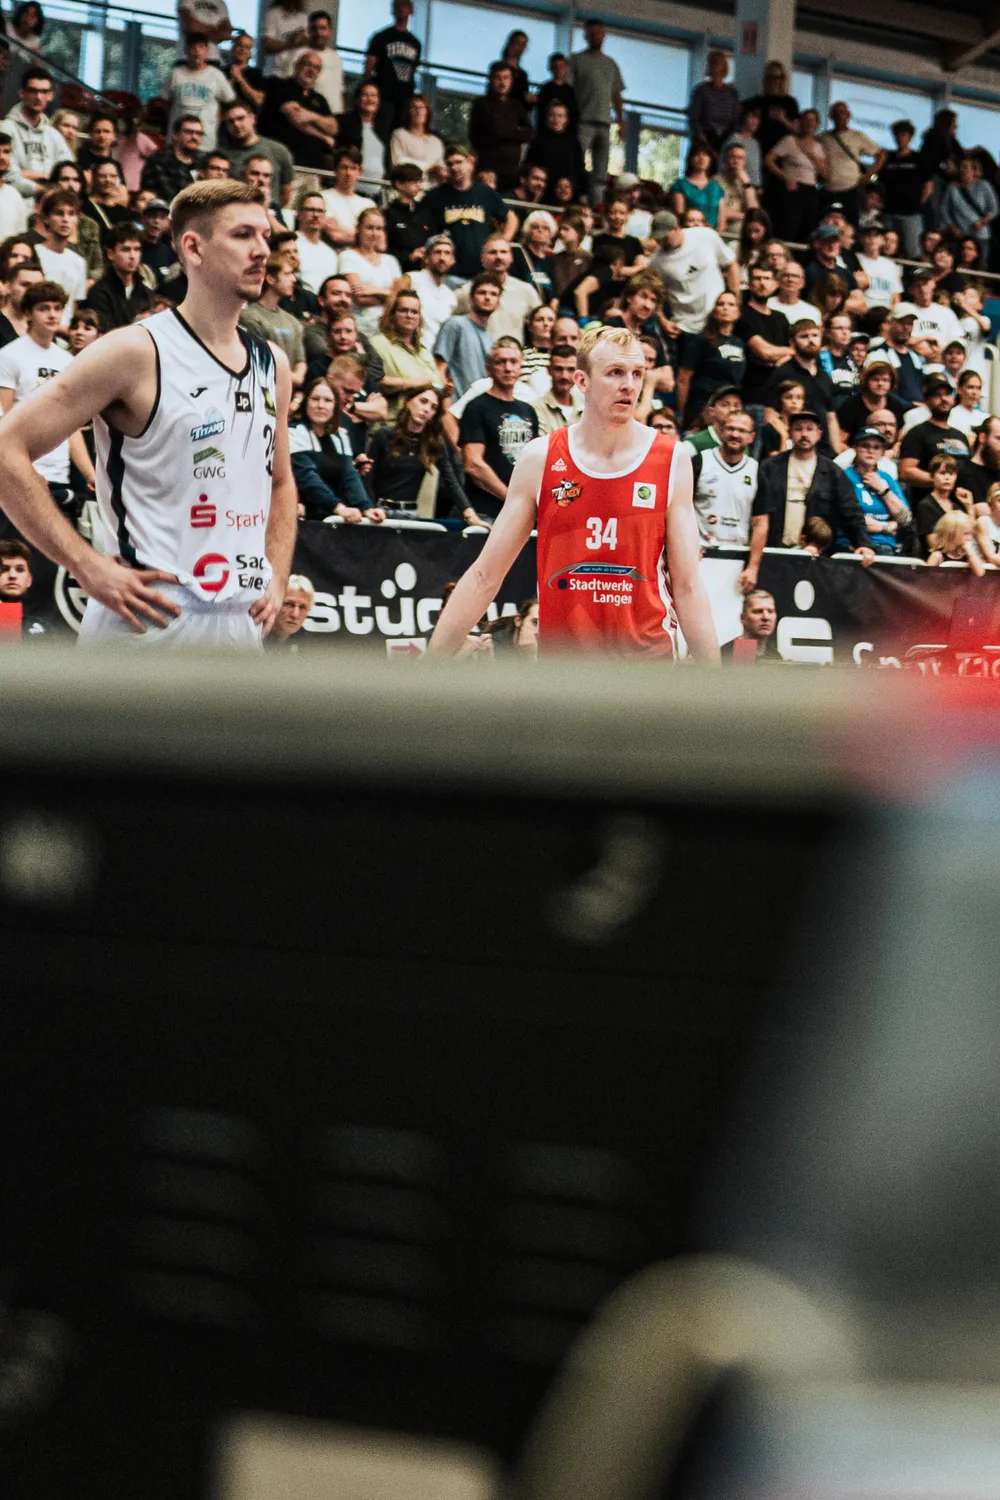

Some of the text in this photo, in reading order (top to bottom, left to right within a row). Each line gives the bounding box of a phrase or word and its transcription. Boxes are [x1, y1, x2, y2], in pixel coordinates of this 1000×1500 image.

[191, 421, 225, 441] TITANS
[193, 466, 226, 480] GWG
[585, 517, 618, 550] 34
[569, 578, 633, 592] Stadtwerke
[593, 591, 632, 607] Langen
